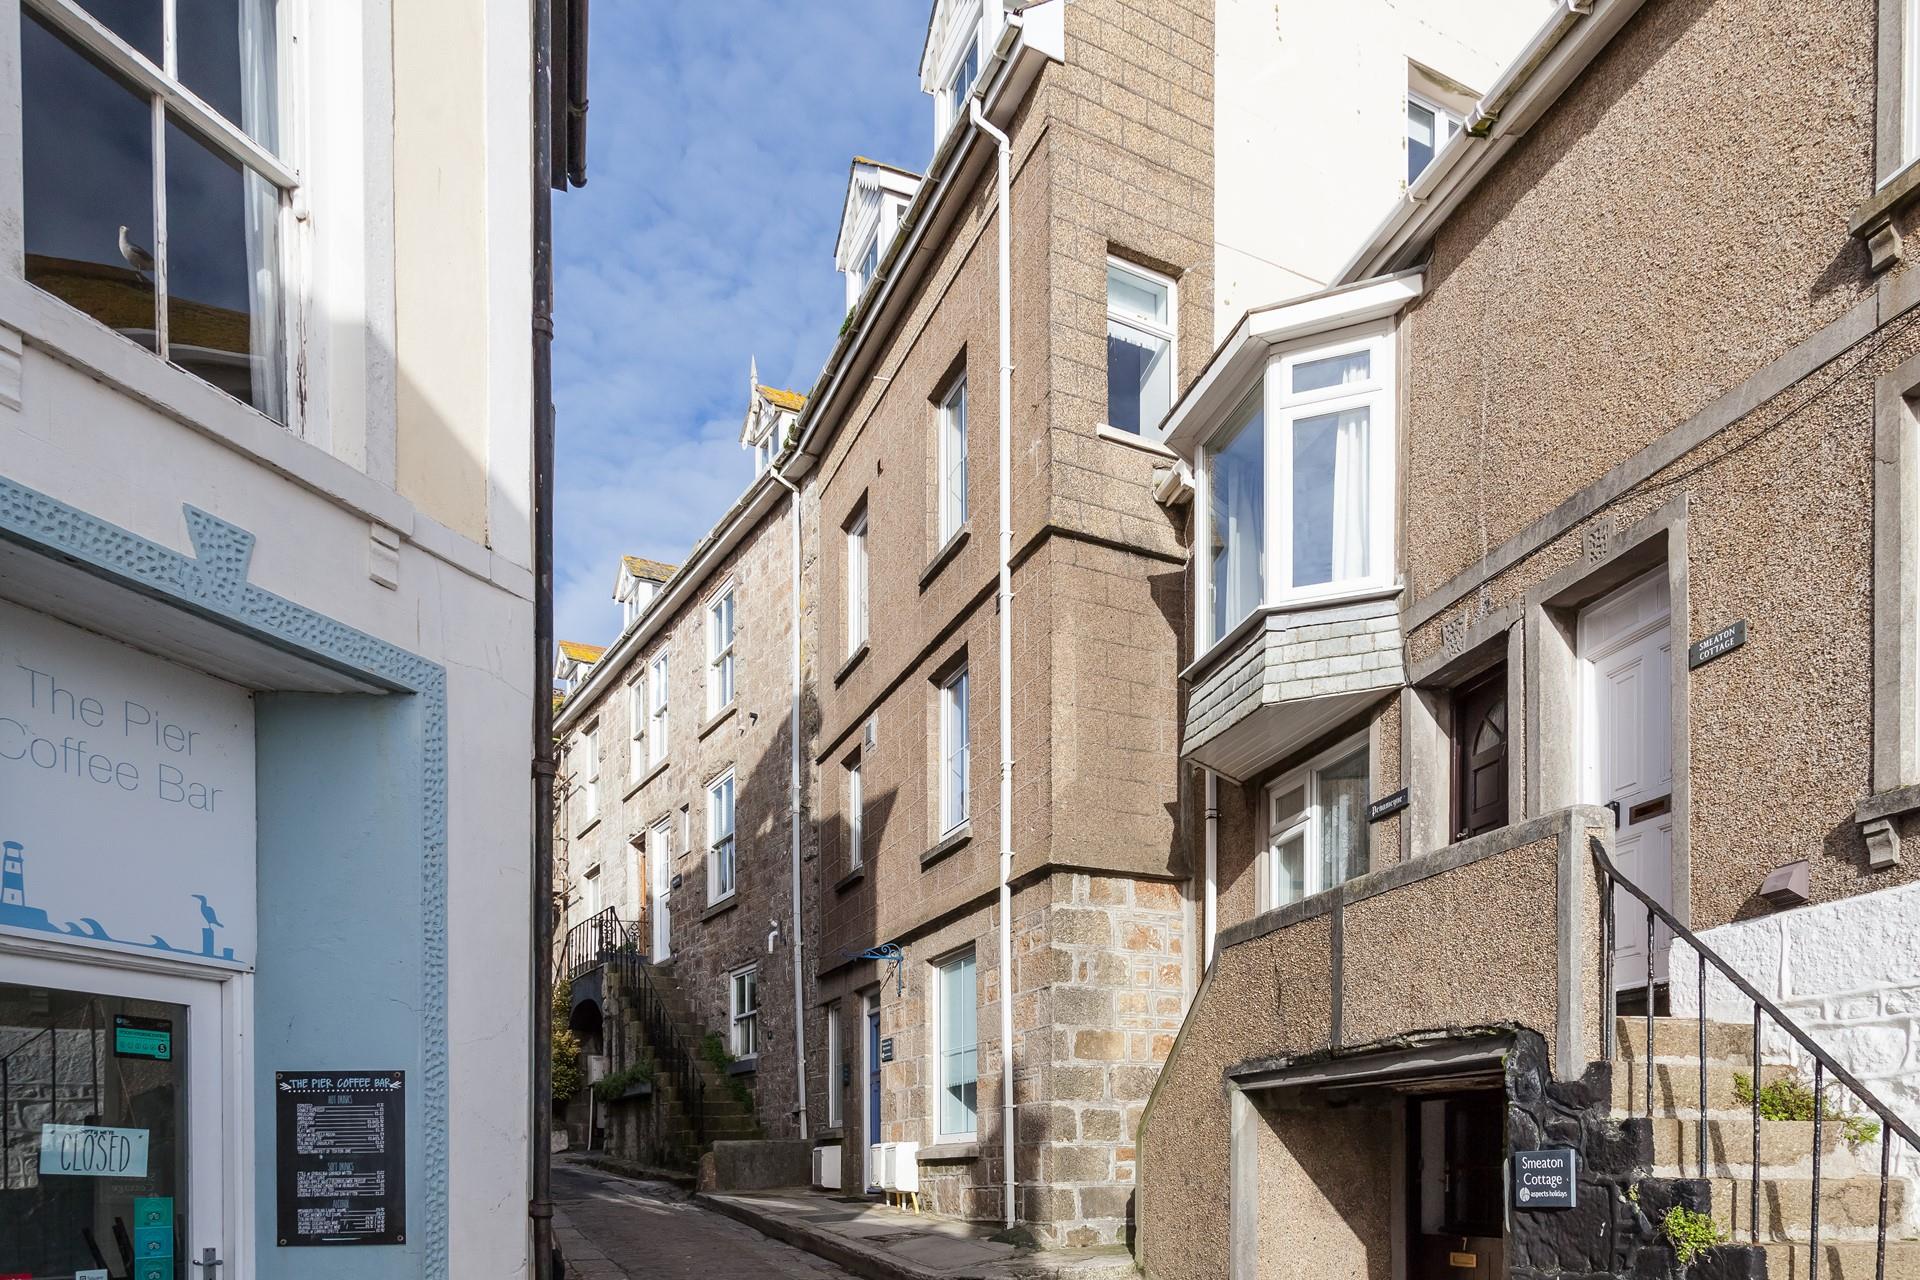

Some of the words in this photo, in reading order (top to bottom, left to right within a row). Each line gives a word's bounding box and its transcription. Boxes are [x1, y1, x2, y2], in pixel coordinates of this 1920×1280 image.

[1699, 626, 1736, 651] SMEATON
[1699, 637, 1735, 660] COTTAGE
[16, 664, 103, 728] The
[125, 700, 200, 756] Pier
[0, 717, 139, 791] Coffee
[159, 763, 223, 812] Bar
[290, 1079, 308, 1089] THE
[311, 1079, 333, 1089] PIER
[337, 1078, 370, 1089] COFFEE
[374, 1078, 391, 1088] BAR
[61, 1133, 130, 1172] CLOSED
[1521, 1156, 1564, 1169] Smeaton
[1523, 1172, 1563, 1188] Cottage
[1549, 1190, 1568, 1198] holidays
